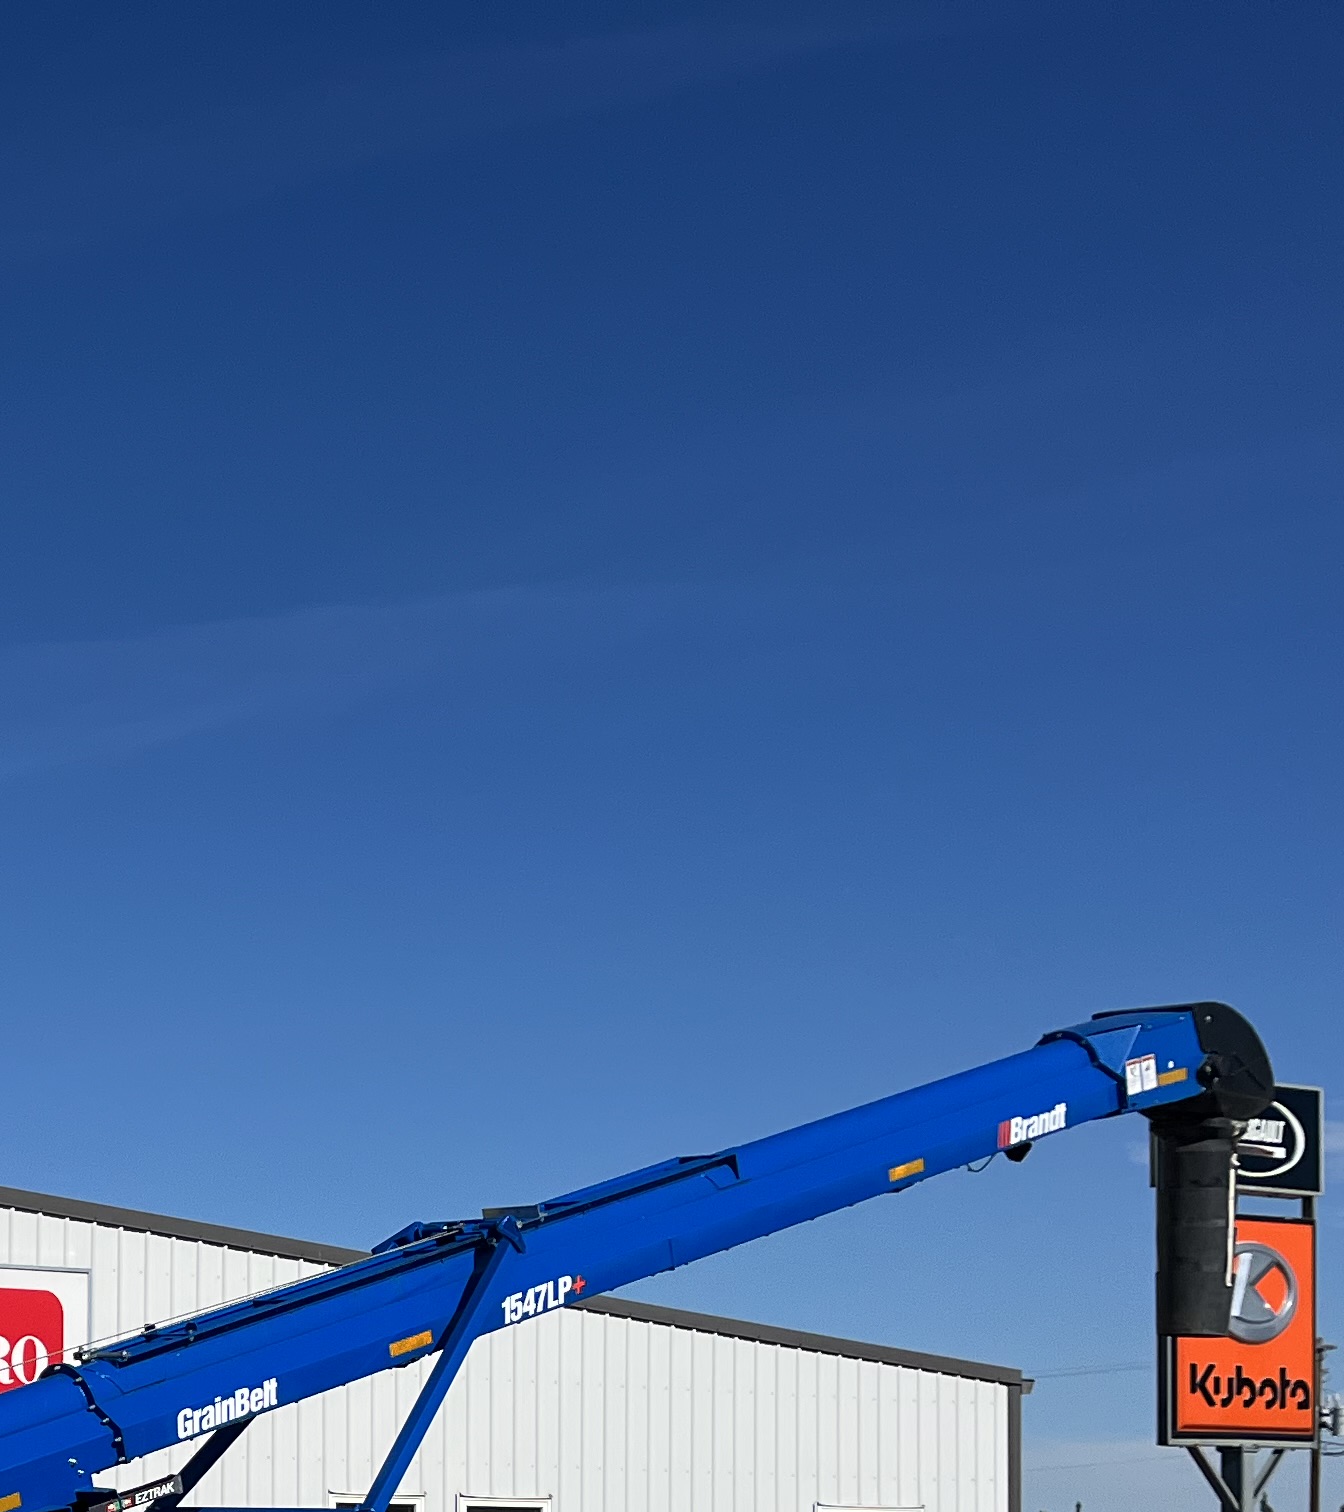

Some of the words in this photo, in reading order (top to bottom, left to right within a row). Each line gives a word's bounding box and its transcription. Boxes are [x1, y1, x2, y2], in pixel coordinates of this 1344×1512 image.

[1009, 1103, 1067, 1145] Brandt
[501, 1275, 586, 1324] 1547LP+
[177, 1377, 278, 1439] GrainBelt
[1189, 1362, 1310, 1410] Kubota
[134, 1481, 176, 1505] EZTRAK
